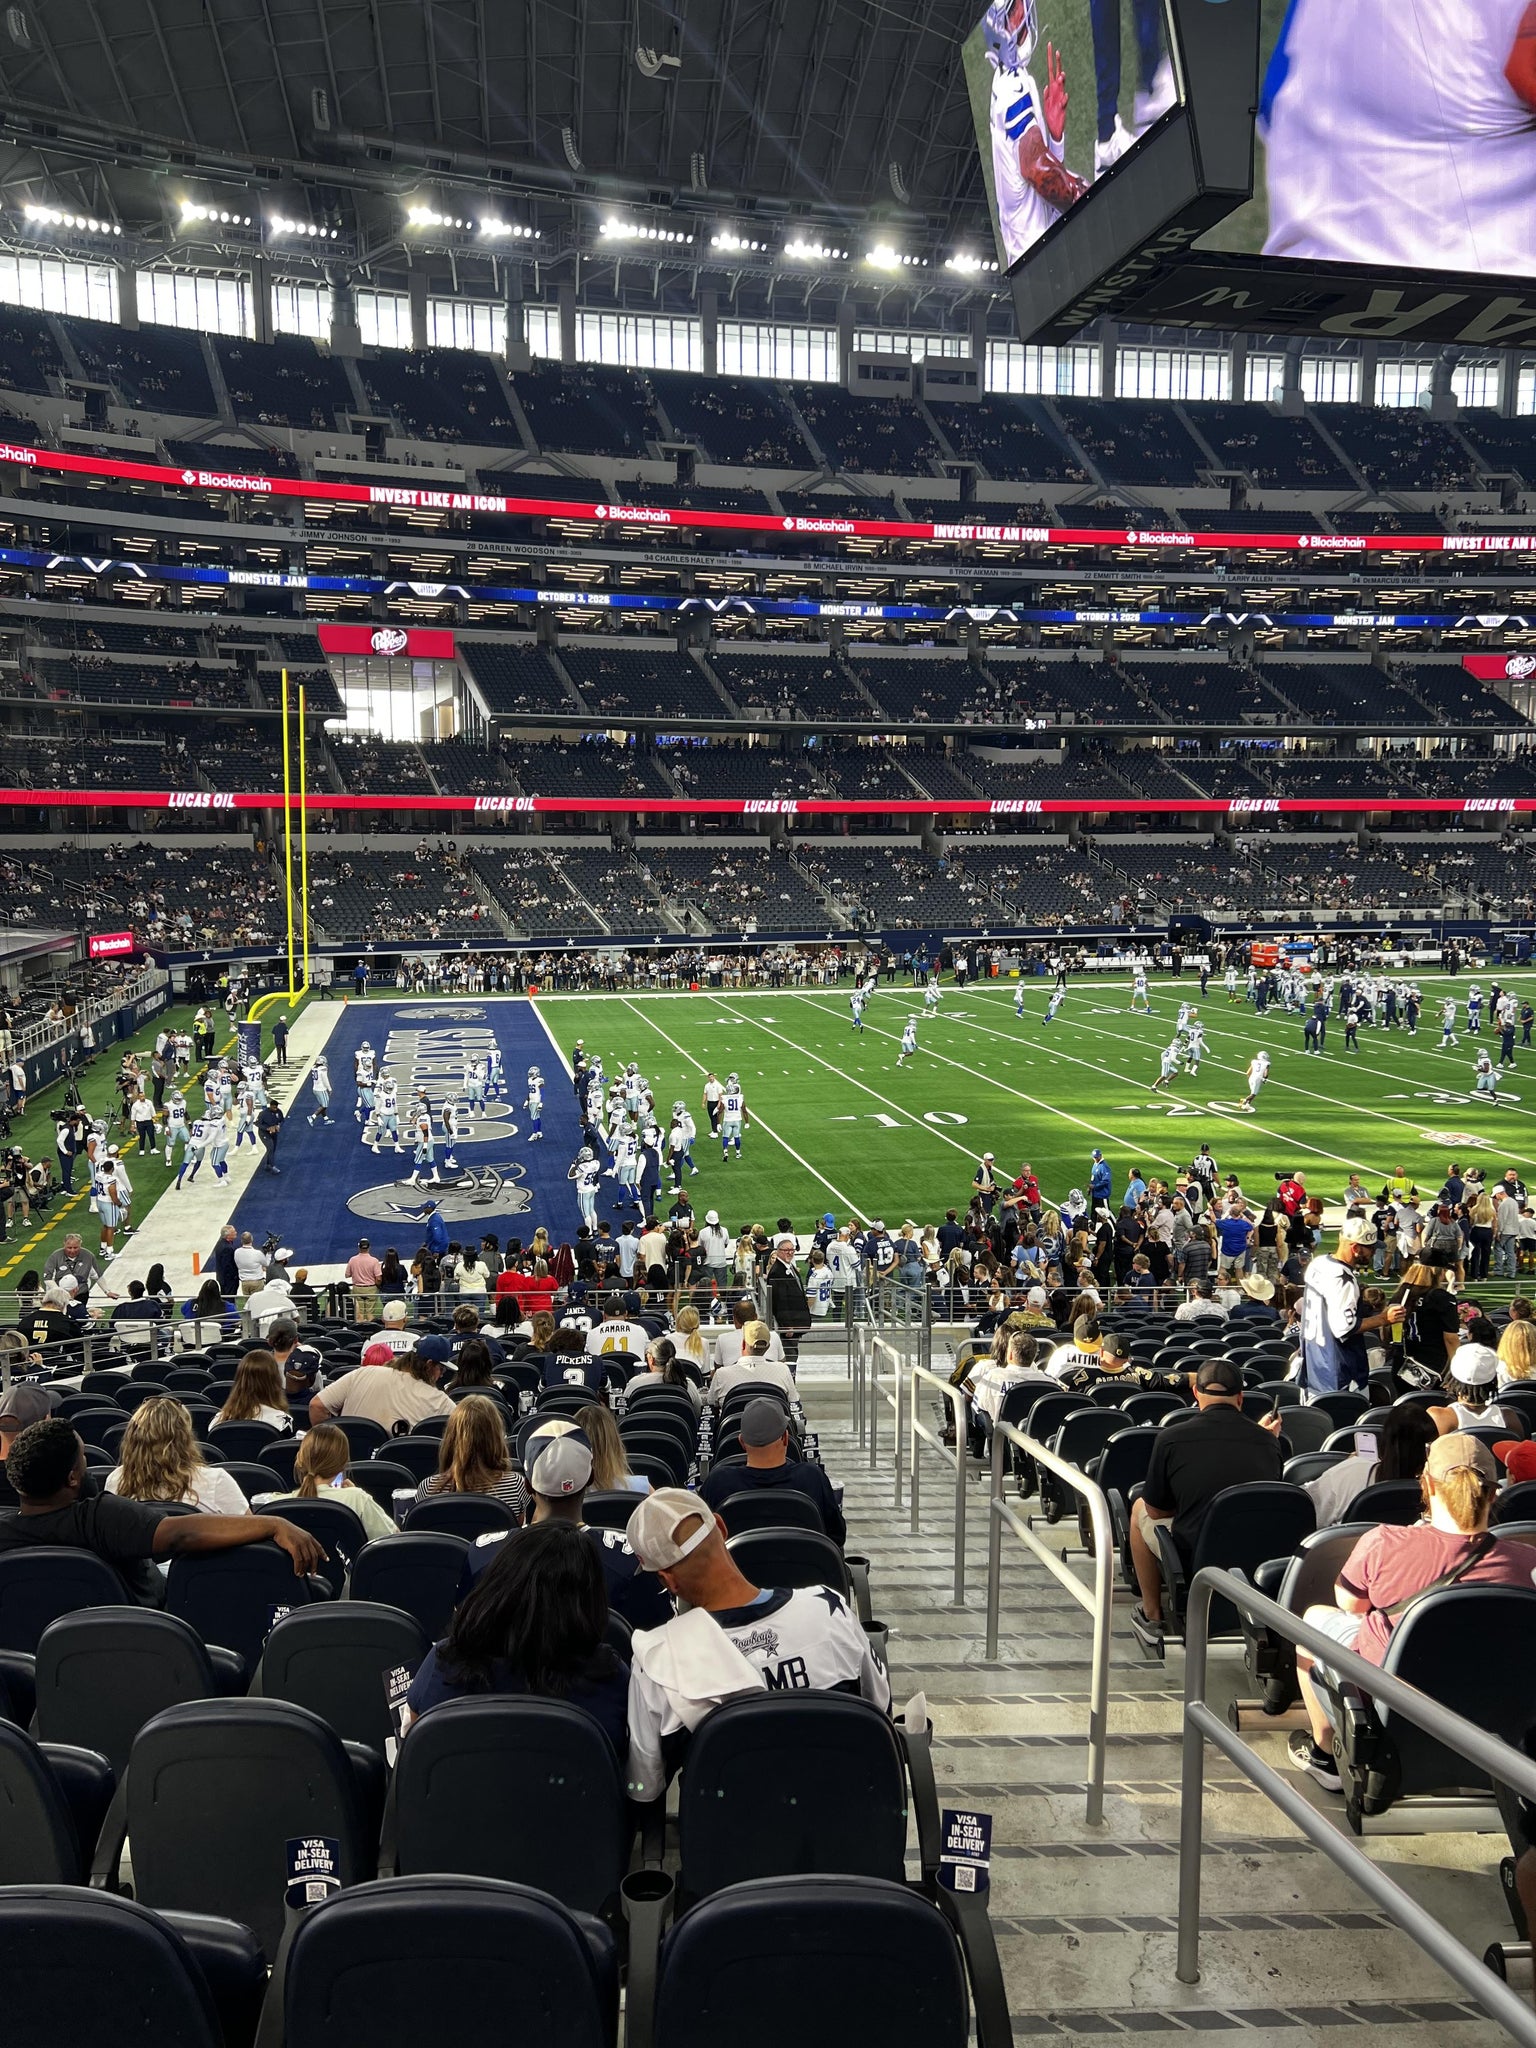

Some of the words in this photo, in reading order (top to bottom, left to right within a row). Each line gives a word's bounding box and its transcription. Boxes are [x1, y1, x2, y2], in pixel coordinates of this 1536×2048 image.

[1054, 227, 1200, 326] WINSTAR
[198, 472, 272, 492] Blockchain
[370, 486, 418, 504] INVEST
[421, 491, 452, 507] LIKE
[453, 493, 472, 509] AN
[474, 496, 506, 512] ICON
[609, 506, 671, 522] Blockchain
[796, 517, 855, 533] Blockchain
[299, 531, 325, 540] JIMMY
[327, 534, 367, 542] JOHNSON
[932, 524, 974, 539] INVEST
[976, 526, 1001, 540] LIKE
[1003, 527, 1019, 541] AN
[1022, 528, 1050, 542] ICON
[1139, 532, 1194, 545] Blockchain
[1310, 535, 1366, 548] Blockchain
[1443, 536, 1483, 550] INVEST
[1485, 536, 1510, 550] LIKE
[1511, 536, 1529, 550] AN
[478, 543, 511, 552] DARREN
[514, 545, 555, 555] WOODSON
[655, 555, 690, 563] CHARLES
[691, 557, 715, 565] HALEY
[813, 563, 843, 571] MICHAEL
[973, 569, 999, 577] AIKMAN
[229, 571, 281, 586] MONSTER
[284, 575, 308, 588] JAM
[537, 591, 575, 603] OCTOBER
[577, 594, 586, 604] 3,
[587, 594, 610, 605] 2026
[820, 604, 861, 616] MONSTER
[864, 606, 883, 617] JAM
[1075, 612, 1110, 622] OCTOBER
[1111, 613, 1119, 622] 3,
[1120, 613, 1140, 622] 2026
[1333, 615, 1374, 626] MONSTER
[1376, 616, 1396, 626] JAM
[375, 631, 404, 651] Pepper
[168, 793, 210, 808] LUCAS
[213, 794, 235, 809] OIL
[474, 797, 514, 811] LUCAS
[516, 798, 535, 811] OIL
[744, 799, 779, 813] LUCAS
[781, 799, 798, 813] OIL
[990, 799, 1024, 813] LUCAS
[1025, 799, 1043, 813] OIL
[1228, 799, 1263, 812] LUCAS
[1264, 799, 1280, 812] OIL
[1463, 799, 1498, 812] LUCAS
[1499, 799, 1516, 812] OIL
[249, 1071, 261, 1082] 73
[728, 1098, 739, 1111] 91
[1146, 1101, 1256, 1116] 20
[172, 1107, 185, 1119] 68
[863, 1111, 969, 1128] 10
[876, 1246, 895, 1266] 13
[832, 1255, 840, 1271] 4
[565, 1307, 587, 1315] JAMES
[34, 1320, 49, 1329] HILL
[600, 1325, 631, 1334] KAMARA
[32, 1331, 48, 1344] 7
[384, 1340, 408, 1349] TTEN
[601, 1337, 628, 1353] 41
[556, 1355, 593, 1365] PICKENS
[390, 1666, 405, 1677] VISA
[761, 1656, 811, 1691] MB
[390, 1671, 410, 1688] IN-SEAT
[956, 1814, 978, 1825] VISA
[951, 1823, 982, 1839] IN-SEAT
[302, 1840, 324, 1848] VISA
[947, 1836, 985, 1852] DELIVERY
[297, 1848, 330, 1859] IN-SEAT
[294, 1859, 334, 1871] DELIVERY
